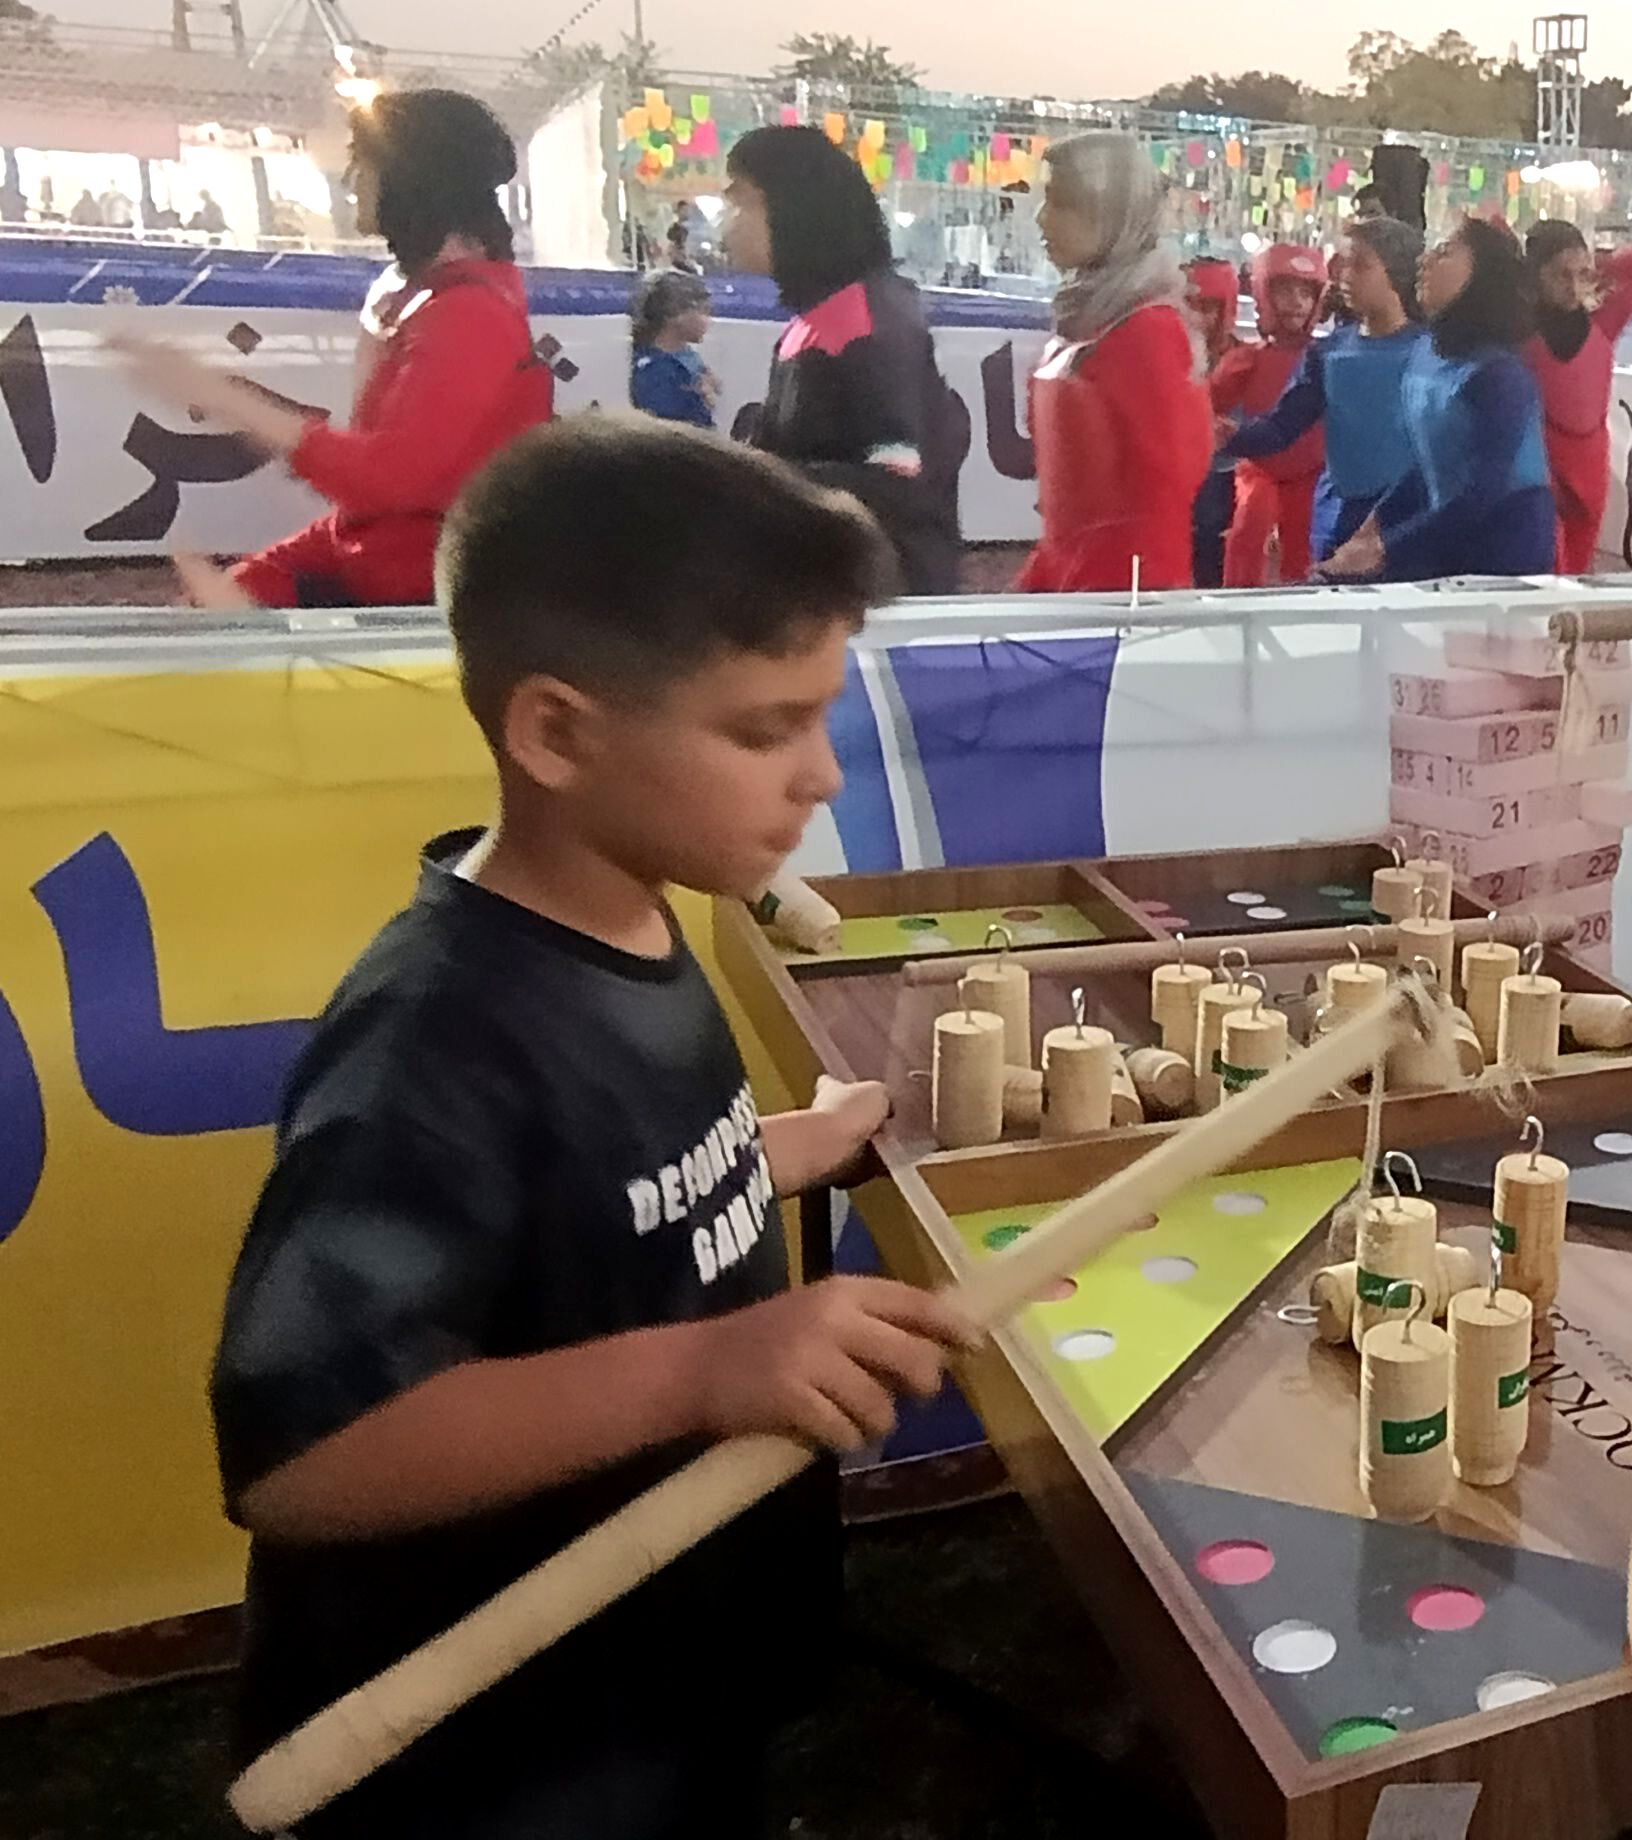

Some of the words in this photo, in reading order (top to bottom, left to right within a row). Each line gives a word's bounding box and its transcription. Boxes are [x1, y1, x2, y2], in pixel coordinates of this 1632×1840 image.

[1489, 725, 1521, 755] 12
[1596, 713, 1619, 740] 11
[1491, 800, 1520, 829] 21
[1586, 853, 1619, 879] 22
[1579, 915, 1607, 945] 20
